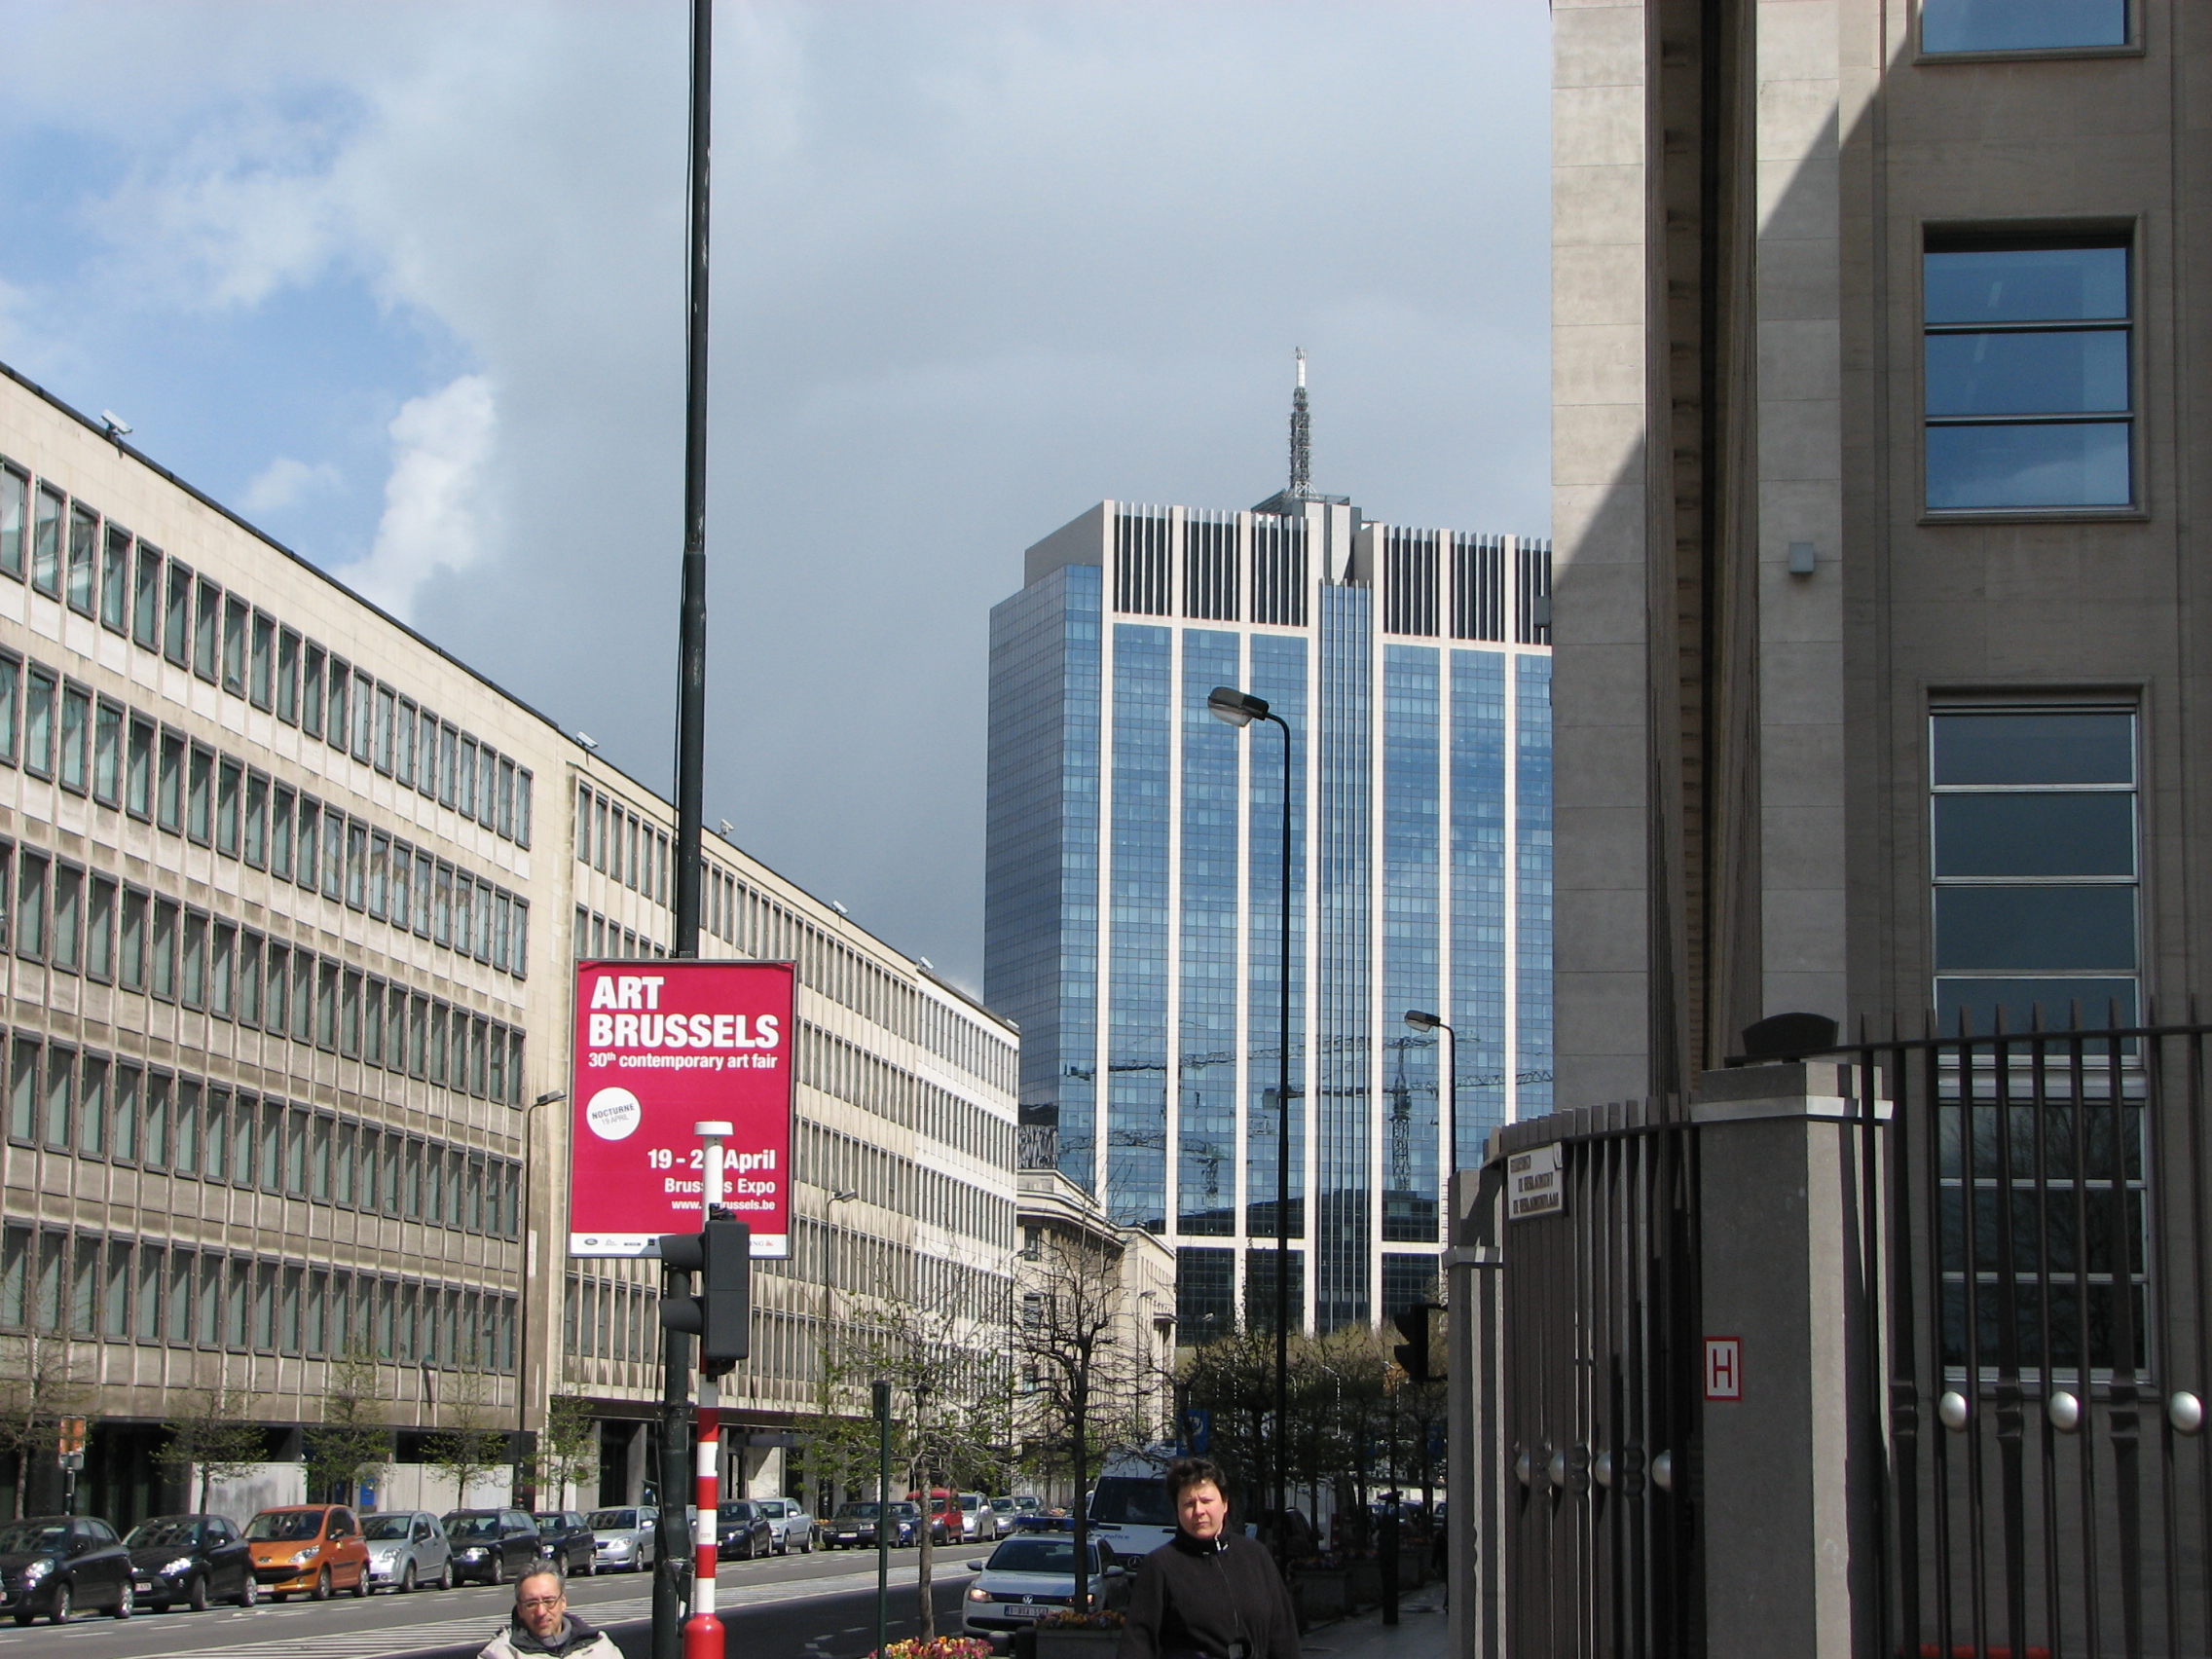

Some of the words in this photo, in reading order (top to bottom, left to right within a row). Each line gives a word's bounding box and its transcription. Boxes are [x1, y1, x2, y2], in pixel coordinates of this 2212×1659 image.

[589, 976, 665, 1010] ART
[588, 1014, 780, 1049] BRUSSELS
[588, 1052, 616, 1068] 30th
[619, 1053, 723, 1071] contemporary
[727, 1054, 749, 1069] art
[752, 1053, 778, 1069] fair
[592, 1103, 636, 1120] NOCTURNE
[610, 1114, 630, 1124] APRIL
[647, 1149, 673, 1169] 19
[723, 1149, 776, 1174] April
[664, 1177, 733, 1194] Bruss
[737, 1178, 776, 1197] Expo
[1712, 1347, 1732, 1388] H
